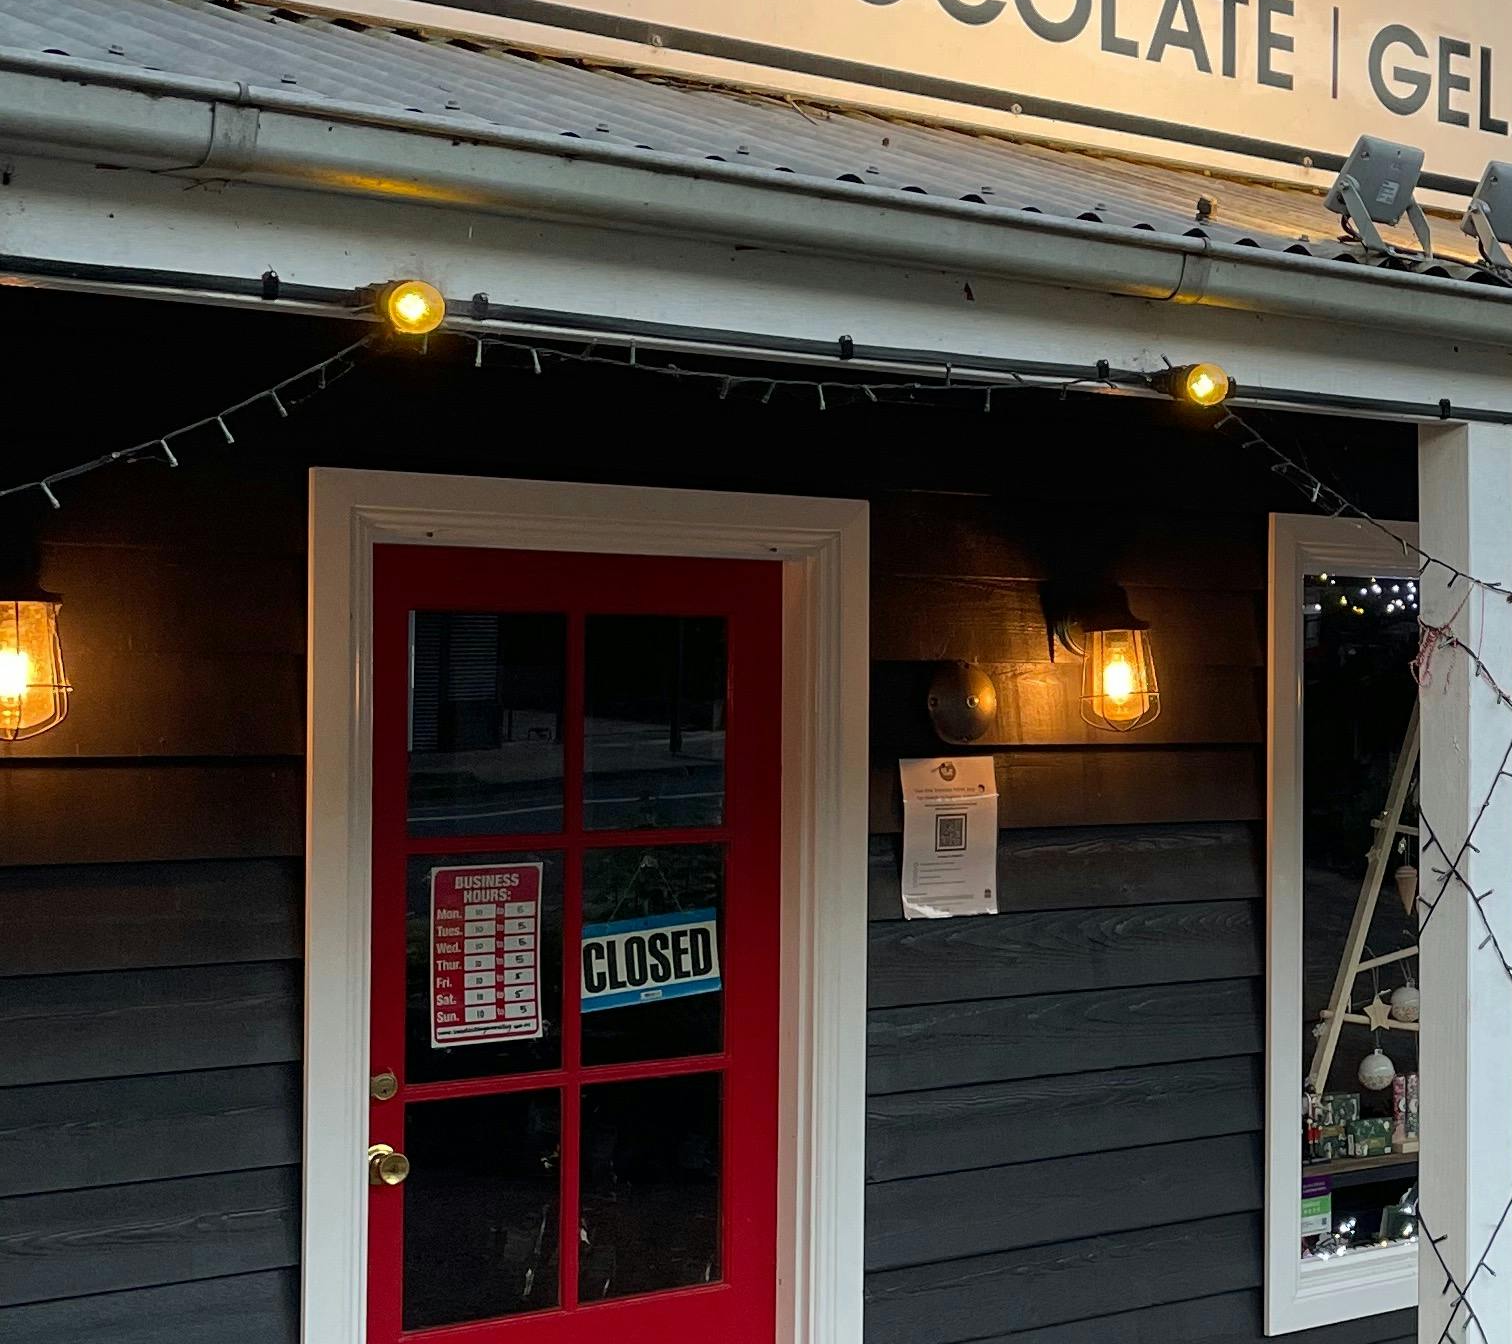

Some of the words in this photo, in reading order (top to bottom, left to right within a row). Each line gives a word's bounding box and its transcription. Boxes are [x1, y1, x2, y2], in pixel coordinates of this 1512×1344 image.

[454, 873, 520, 889] BUSINESS
[463, 888, 512, 903] HOURS:
[436, 909, 462, 920] Mon.
[437, 925, 463, 937] Tues.
[436, 942, 462, 954] Wed.
[436, 960, 462, 971] Thur.
[582, 927, 713, 994] CLOSED
[436, 977, 453, 988] Fri.
[436, 993, 457, 1006] Sat.
[436, 1011, 460, 1023] Sun.
